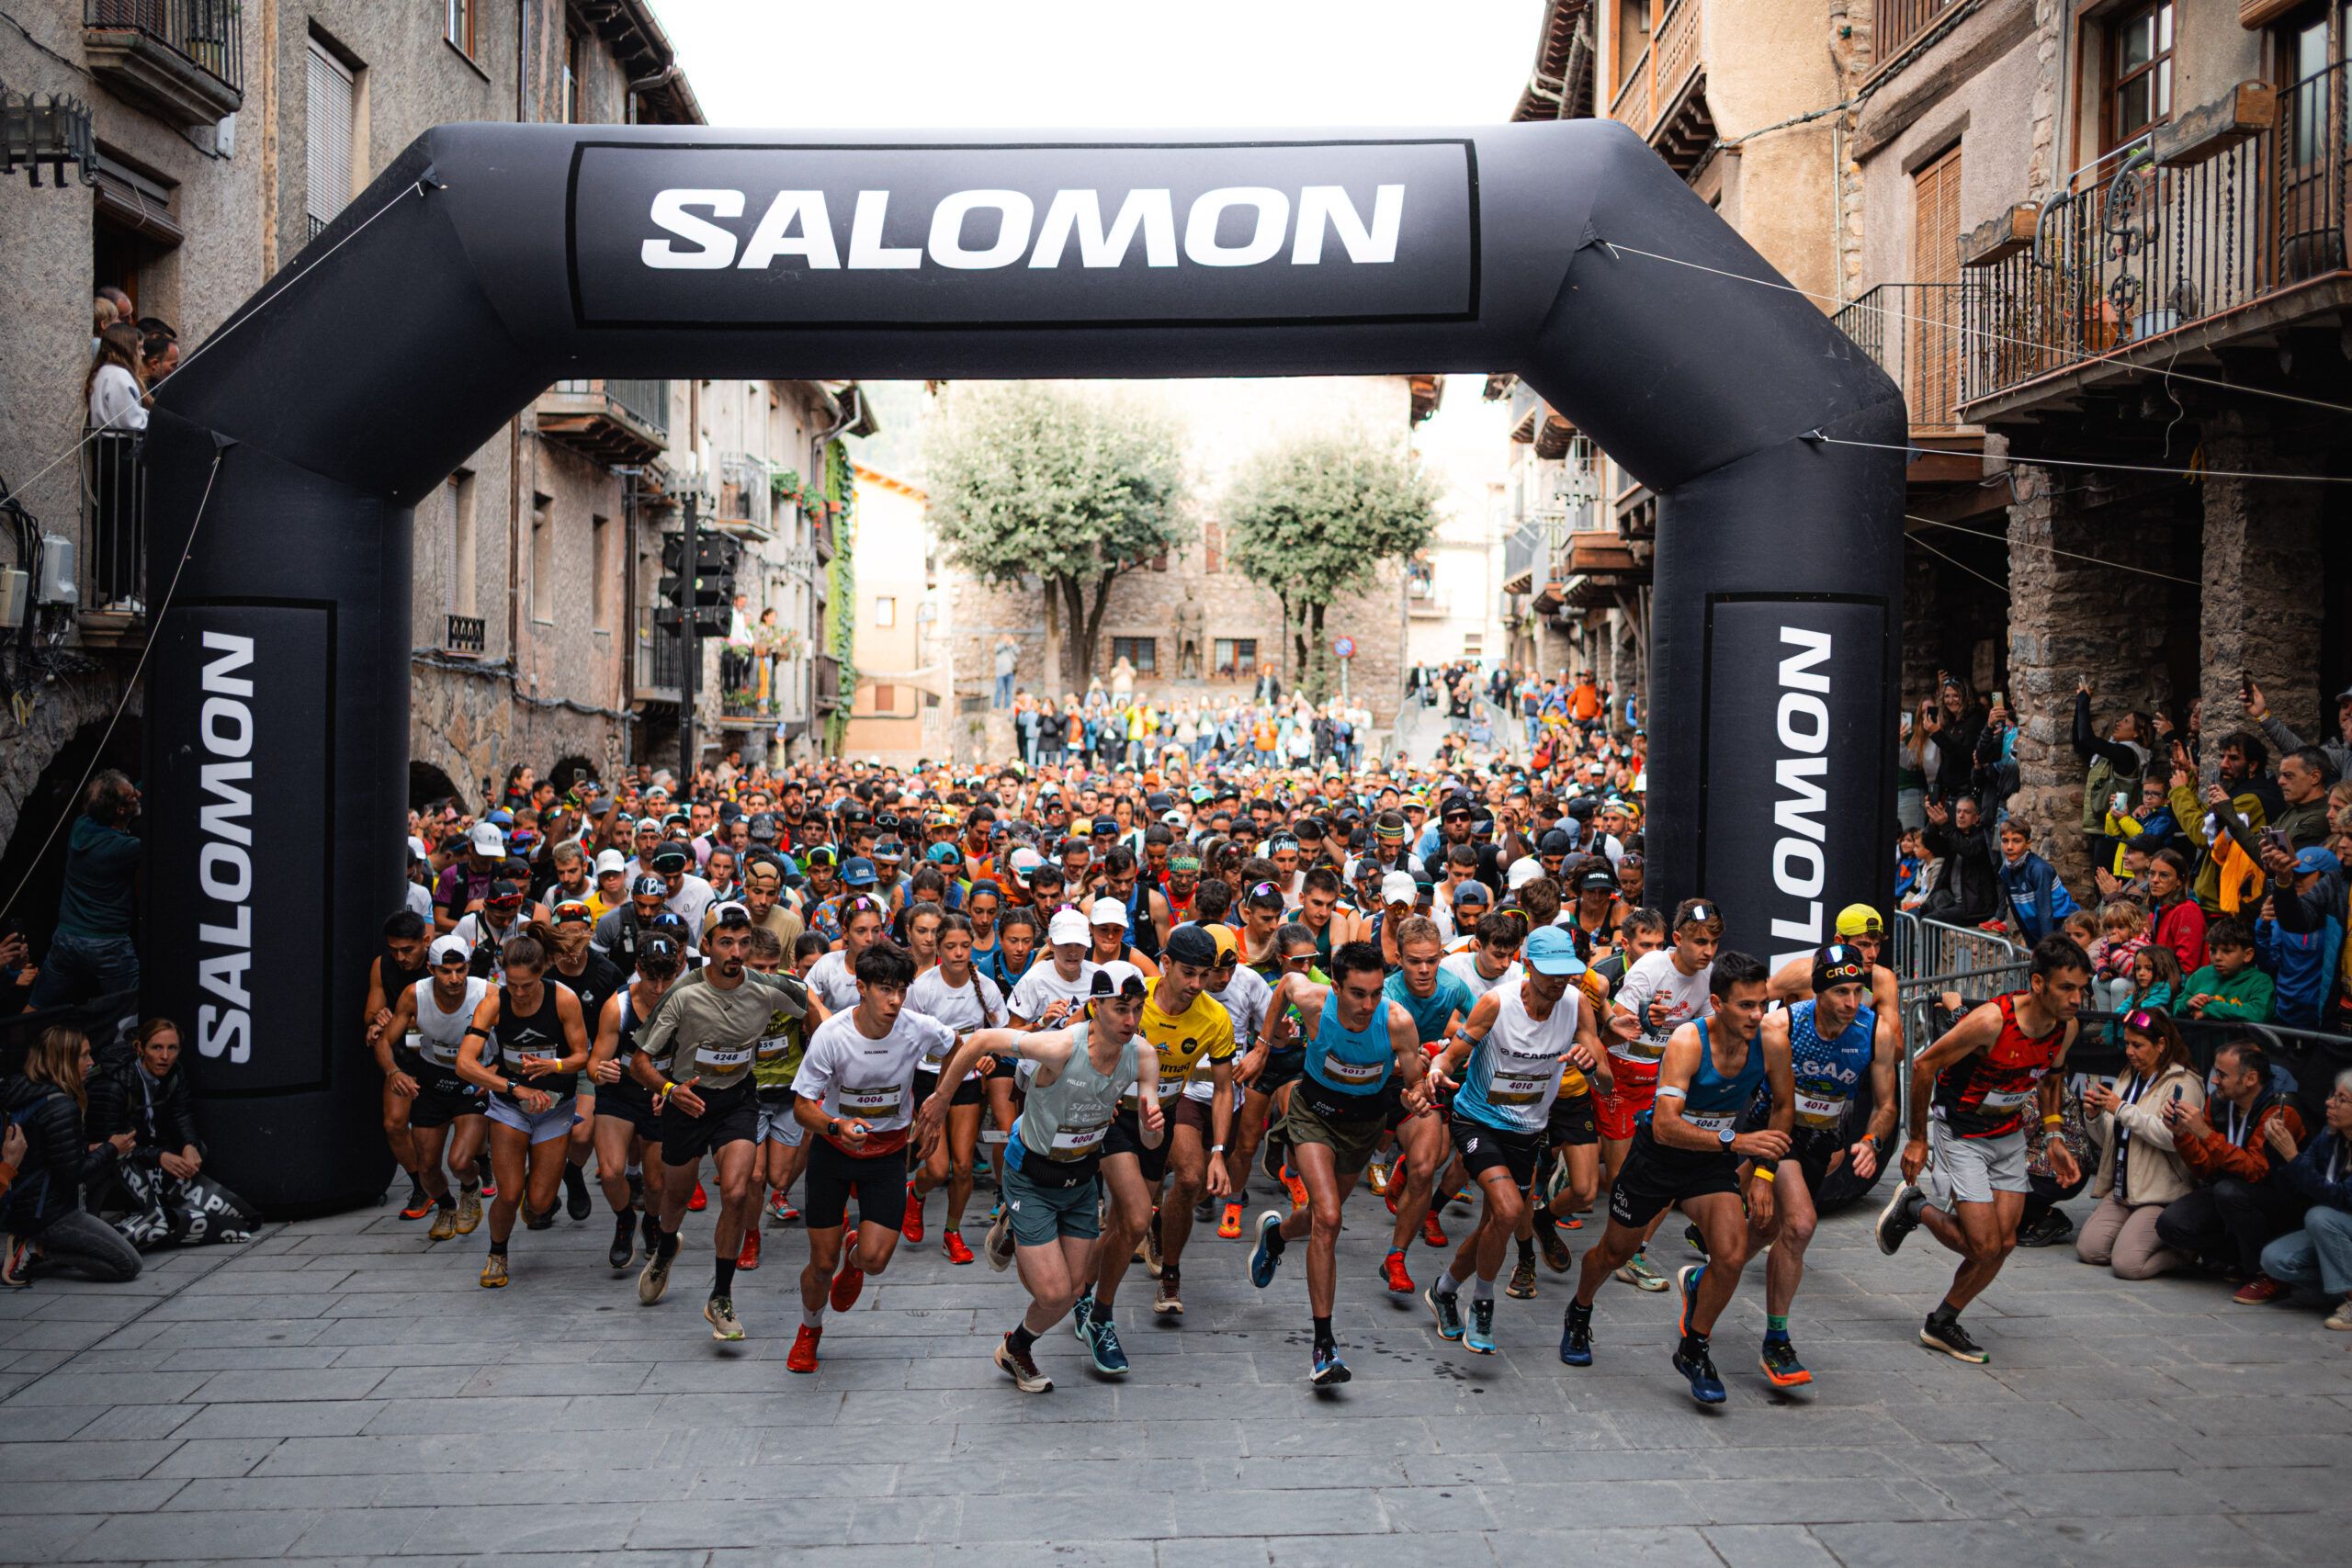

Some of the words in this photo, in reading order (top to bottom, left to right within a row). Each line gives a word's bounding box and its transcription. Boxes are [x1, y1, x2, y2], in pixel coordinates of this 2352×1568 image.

[641, 184, 1406, 271] SALOMON
[1768, 626, 1832, 977] LOMON
[198, 631, 254, 1064] SALOMON
[713, 1053, 739, 1061] 4248
[1341, 1067, 1366, 1076] 4013
[1067, 1077, 1087, 1088] MILLET
[1804, 1100, 1830, 1111] 4014
[1694, 1119, 1720, 1127] 5062
[1071, 1134, 1095, 1144] 4008
